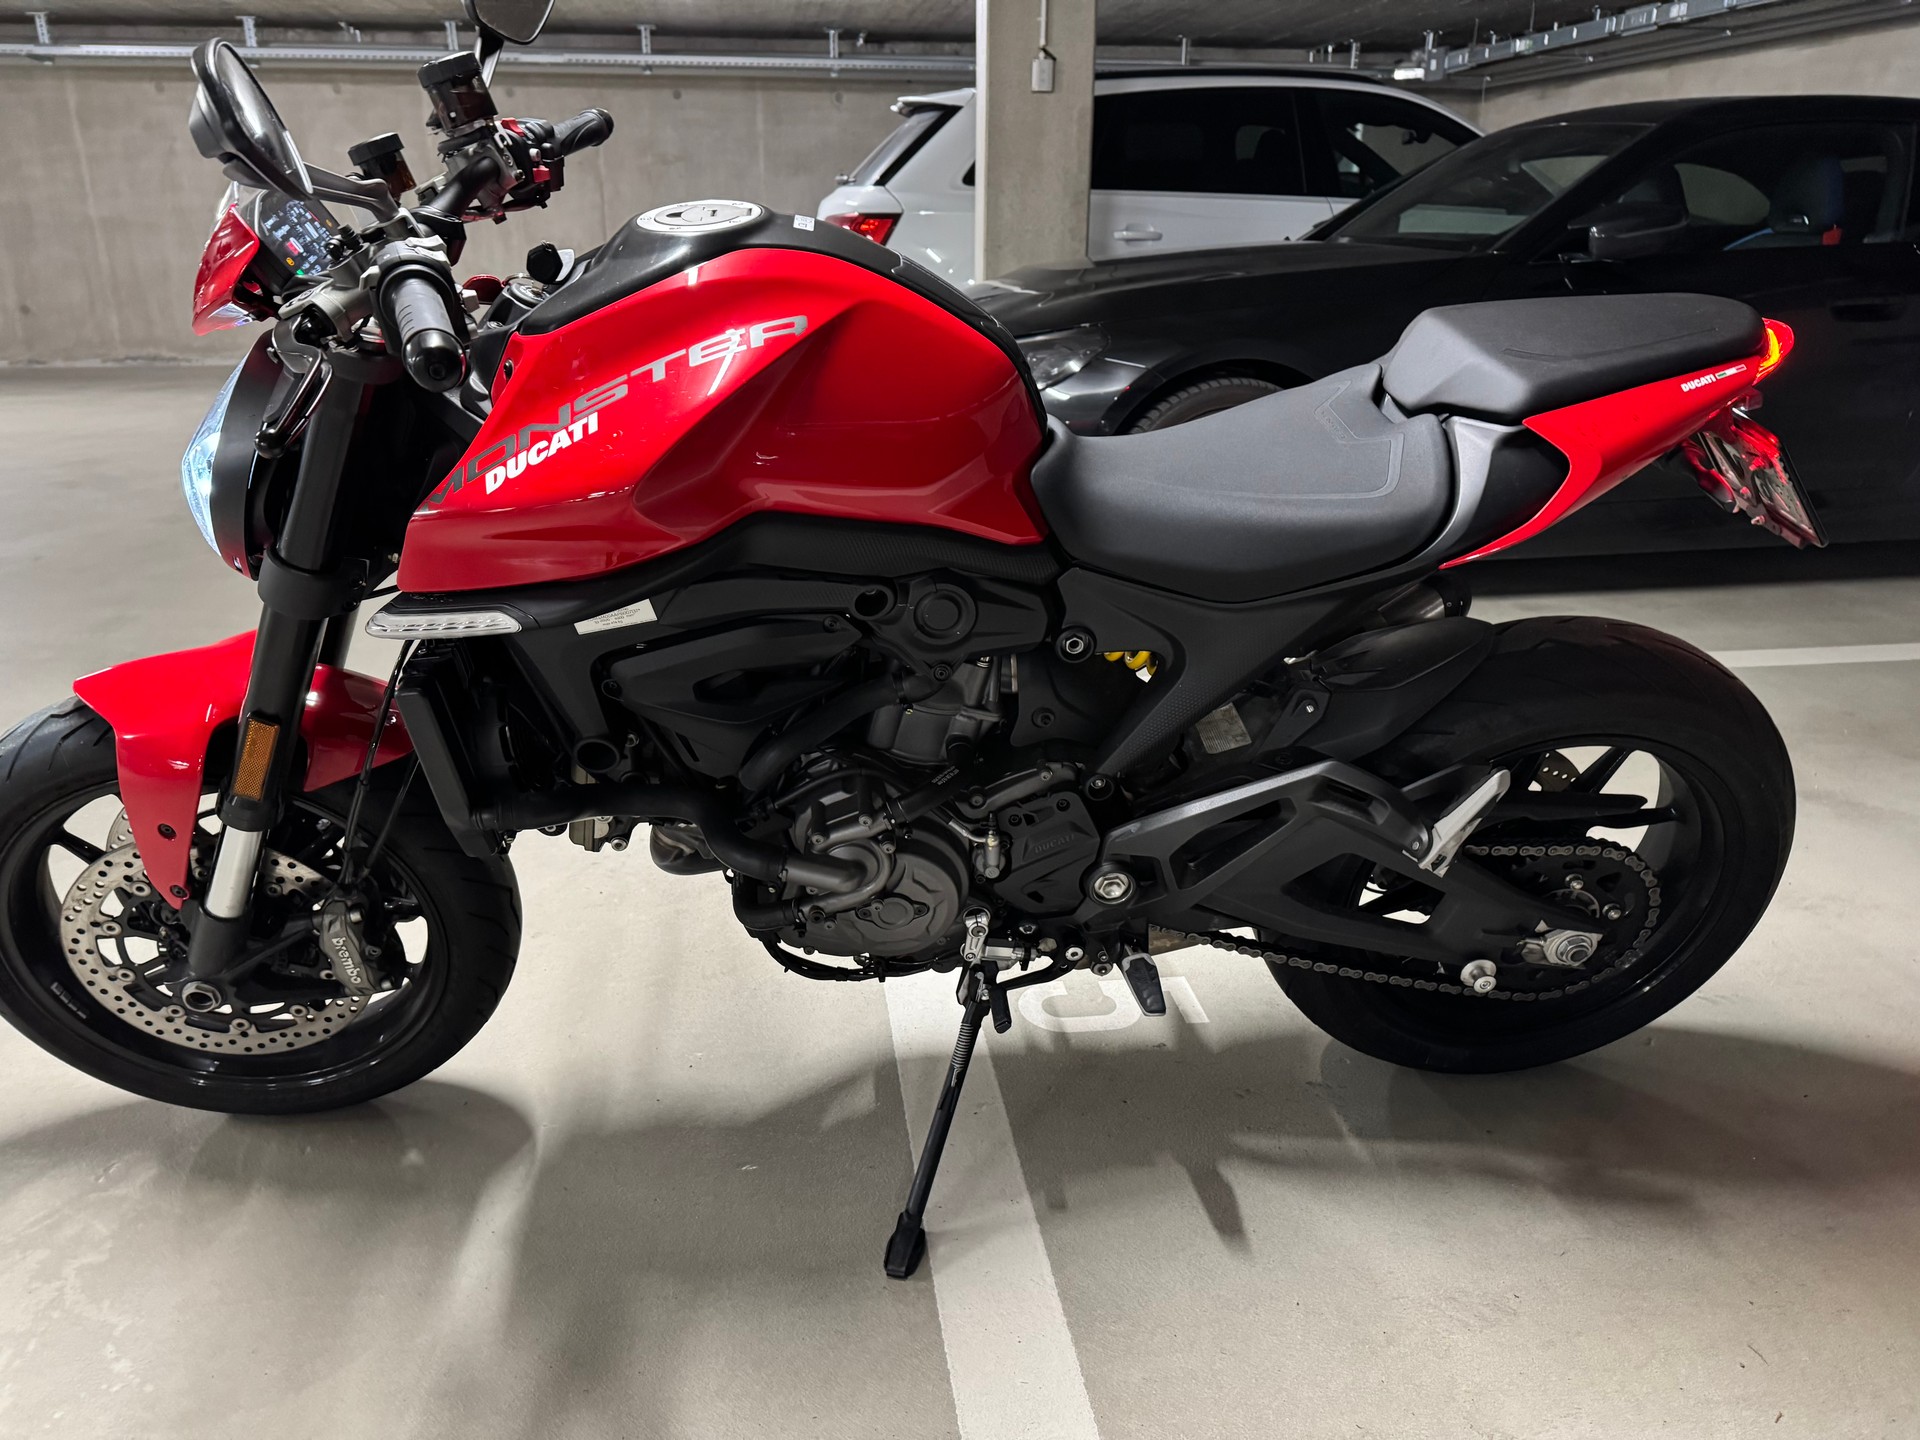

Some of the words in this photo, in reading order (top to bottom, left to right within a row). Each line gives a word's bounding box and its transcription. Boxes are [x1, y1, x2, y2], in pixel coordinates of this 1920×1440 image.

[1680, 373, 1717, 392] DUCATI
[420, 315, 809, 512] MONSTER
[485, 412, 599, 495] DUCATI
[1034, 833, 1076, 854] DUCATI
[331, 937, 362, 984] brembo
